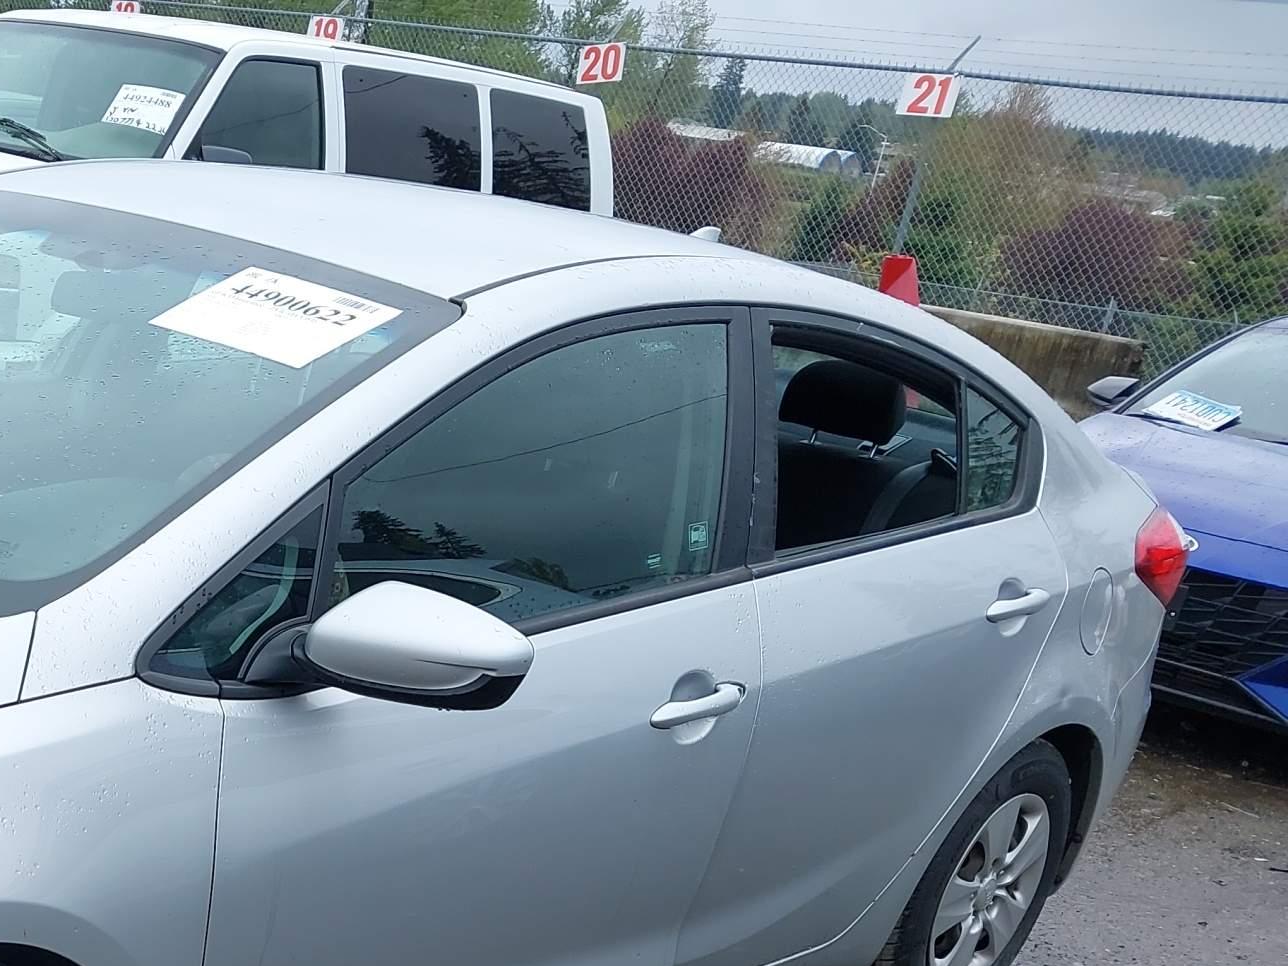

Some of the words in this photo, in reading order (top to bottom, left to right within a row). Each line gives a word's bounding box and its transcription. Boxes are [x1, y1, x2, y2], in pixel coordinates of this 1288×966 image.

[580, 44, 622, 82] 20
[123, 93, 173, 109] 44924488
[906, 75, 953, 115] 21
[231, 284, 358, 327] 44900622
